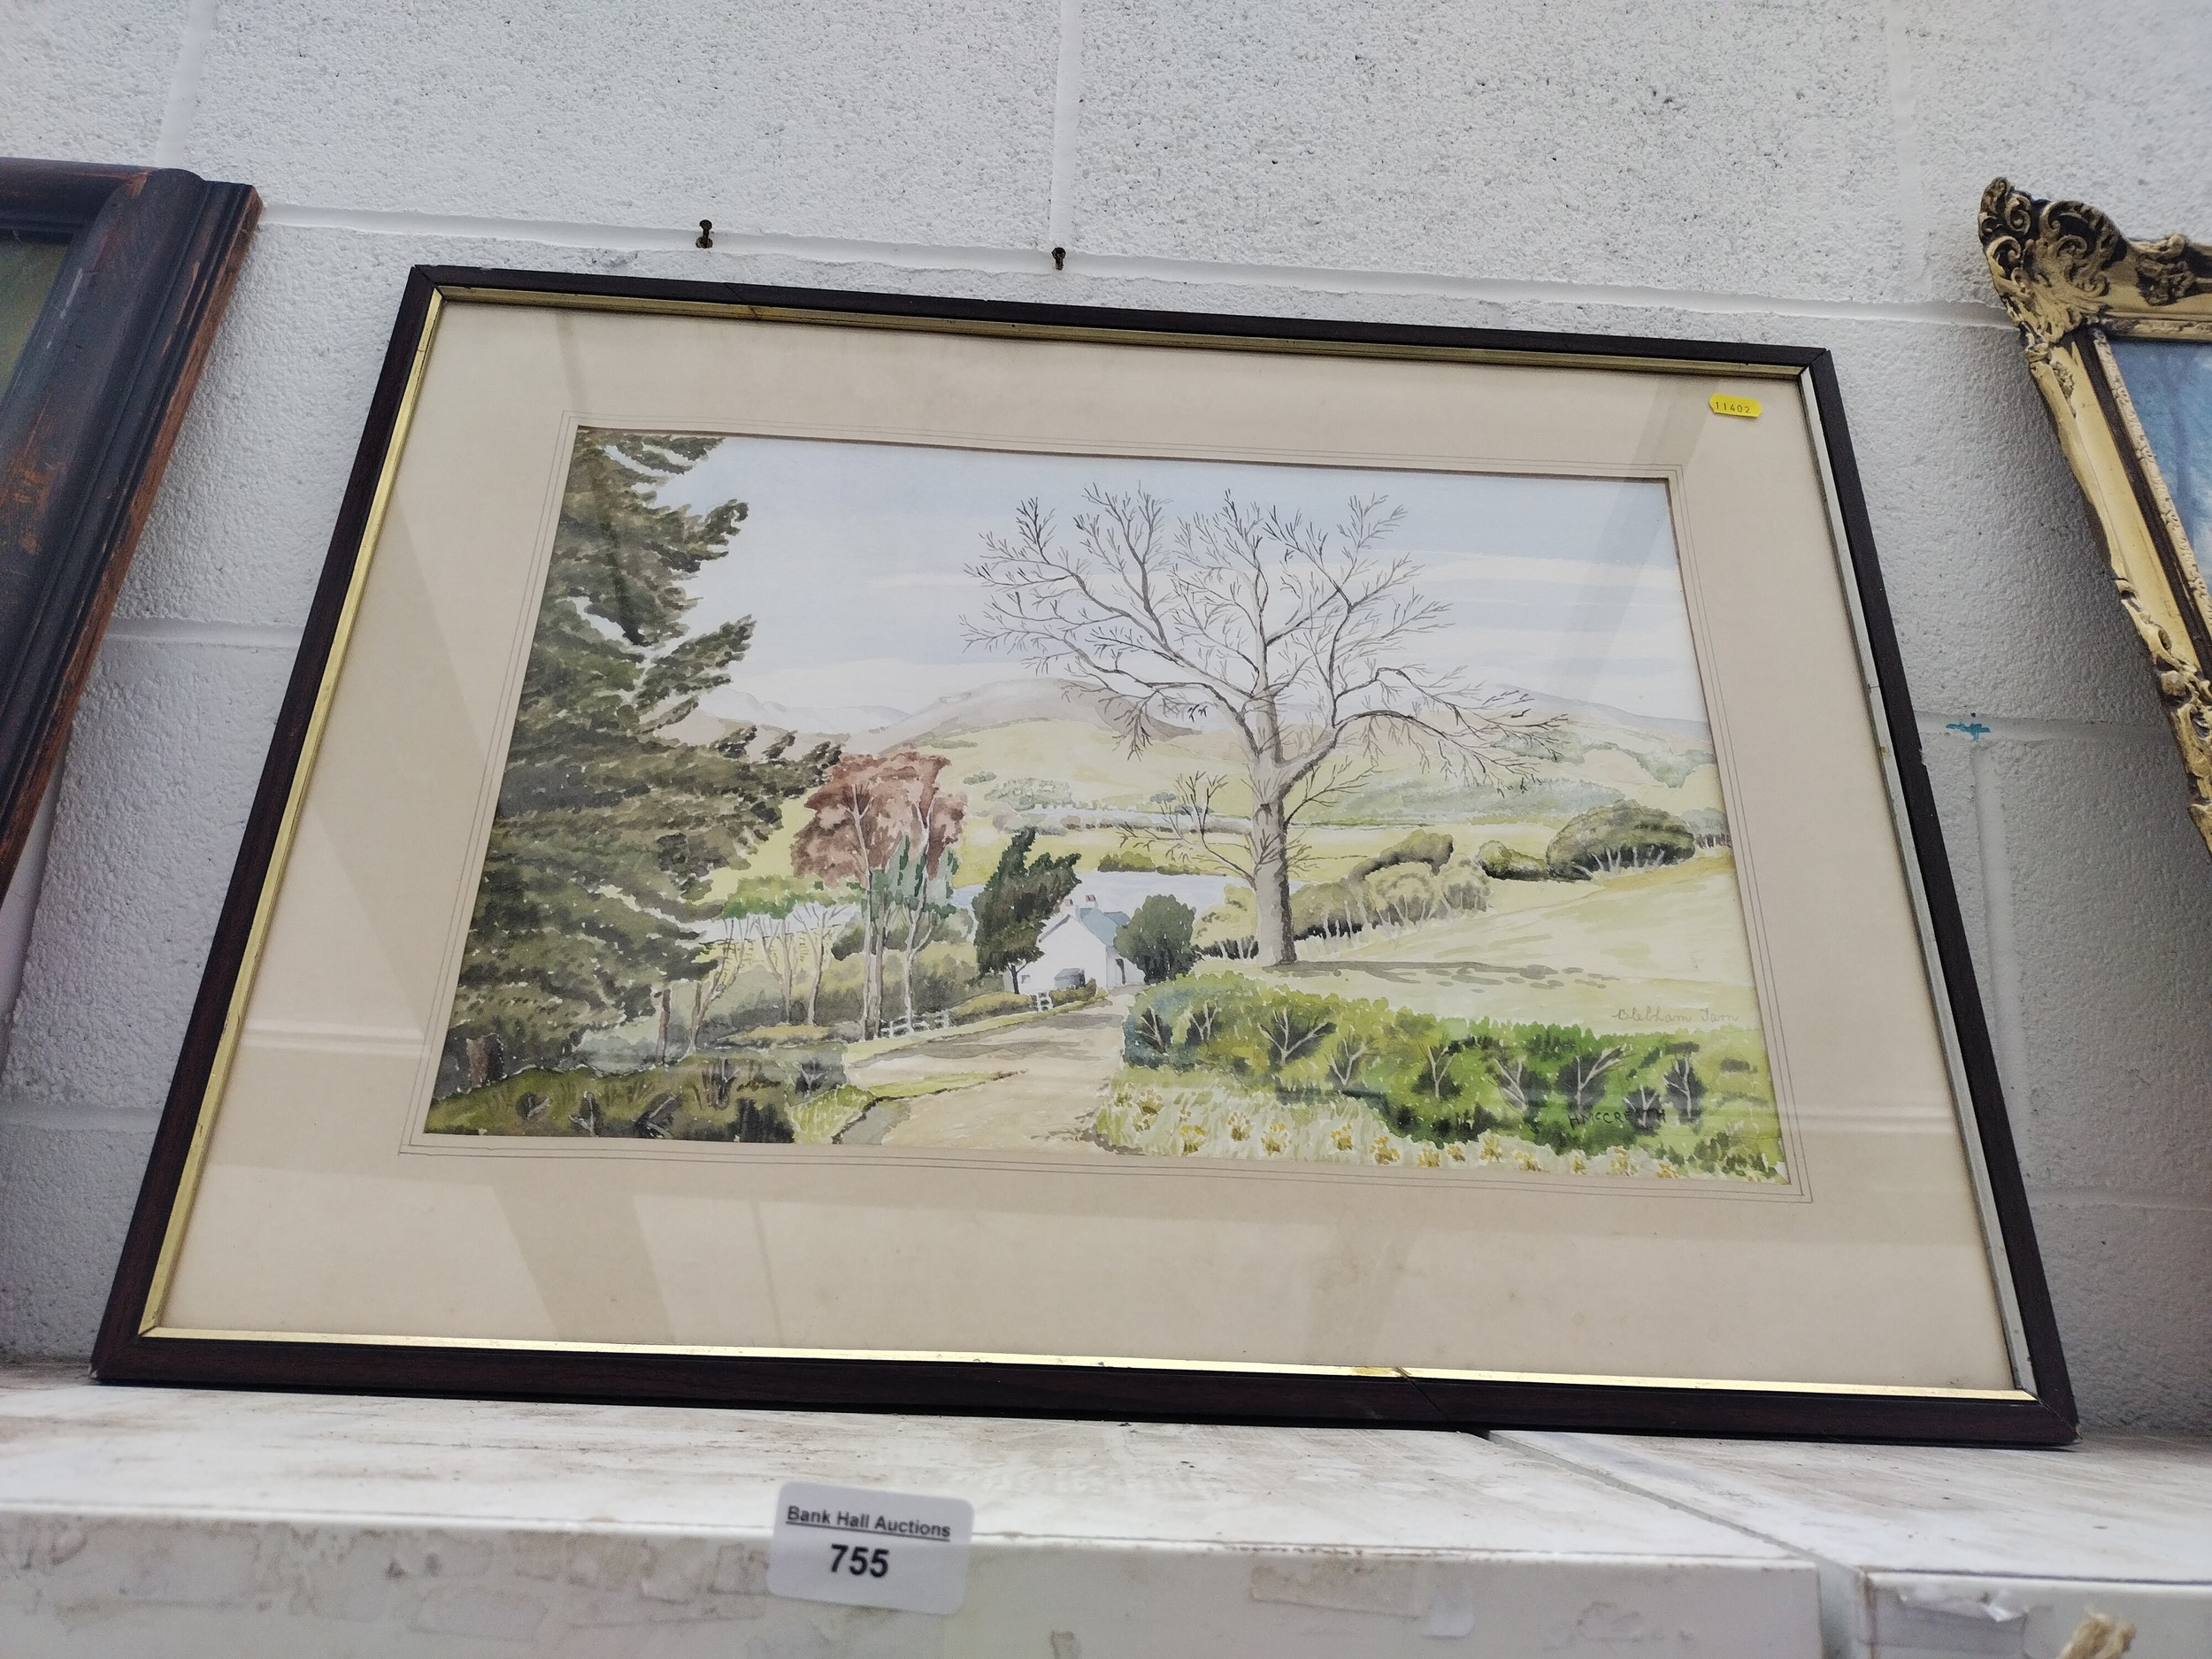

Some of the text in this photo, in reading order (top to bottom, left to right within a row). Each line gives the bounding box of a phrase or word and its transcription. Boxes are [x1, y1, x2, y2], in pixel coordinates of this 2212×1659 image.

[1715, 401, 1751, 414] 11402
[787, 1505, 951, 1538] Bank Hall Auctions
[830, 1543, 889, 1578] 755
